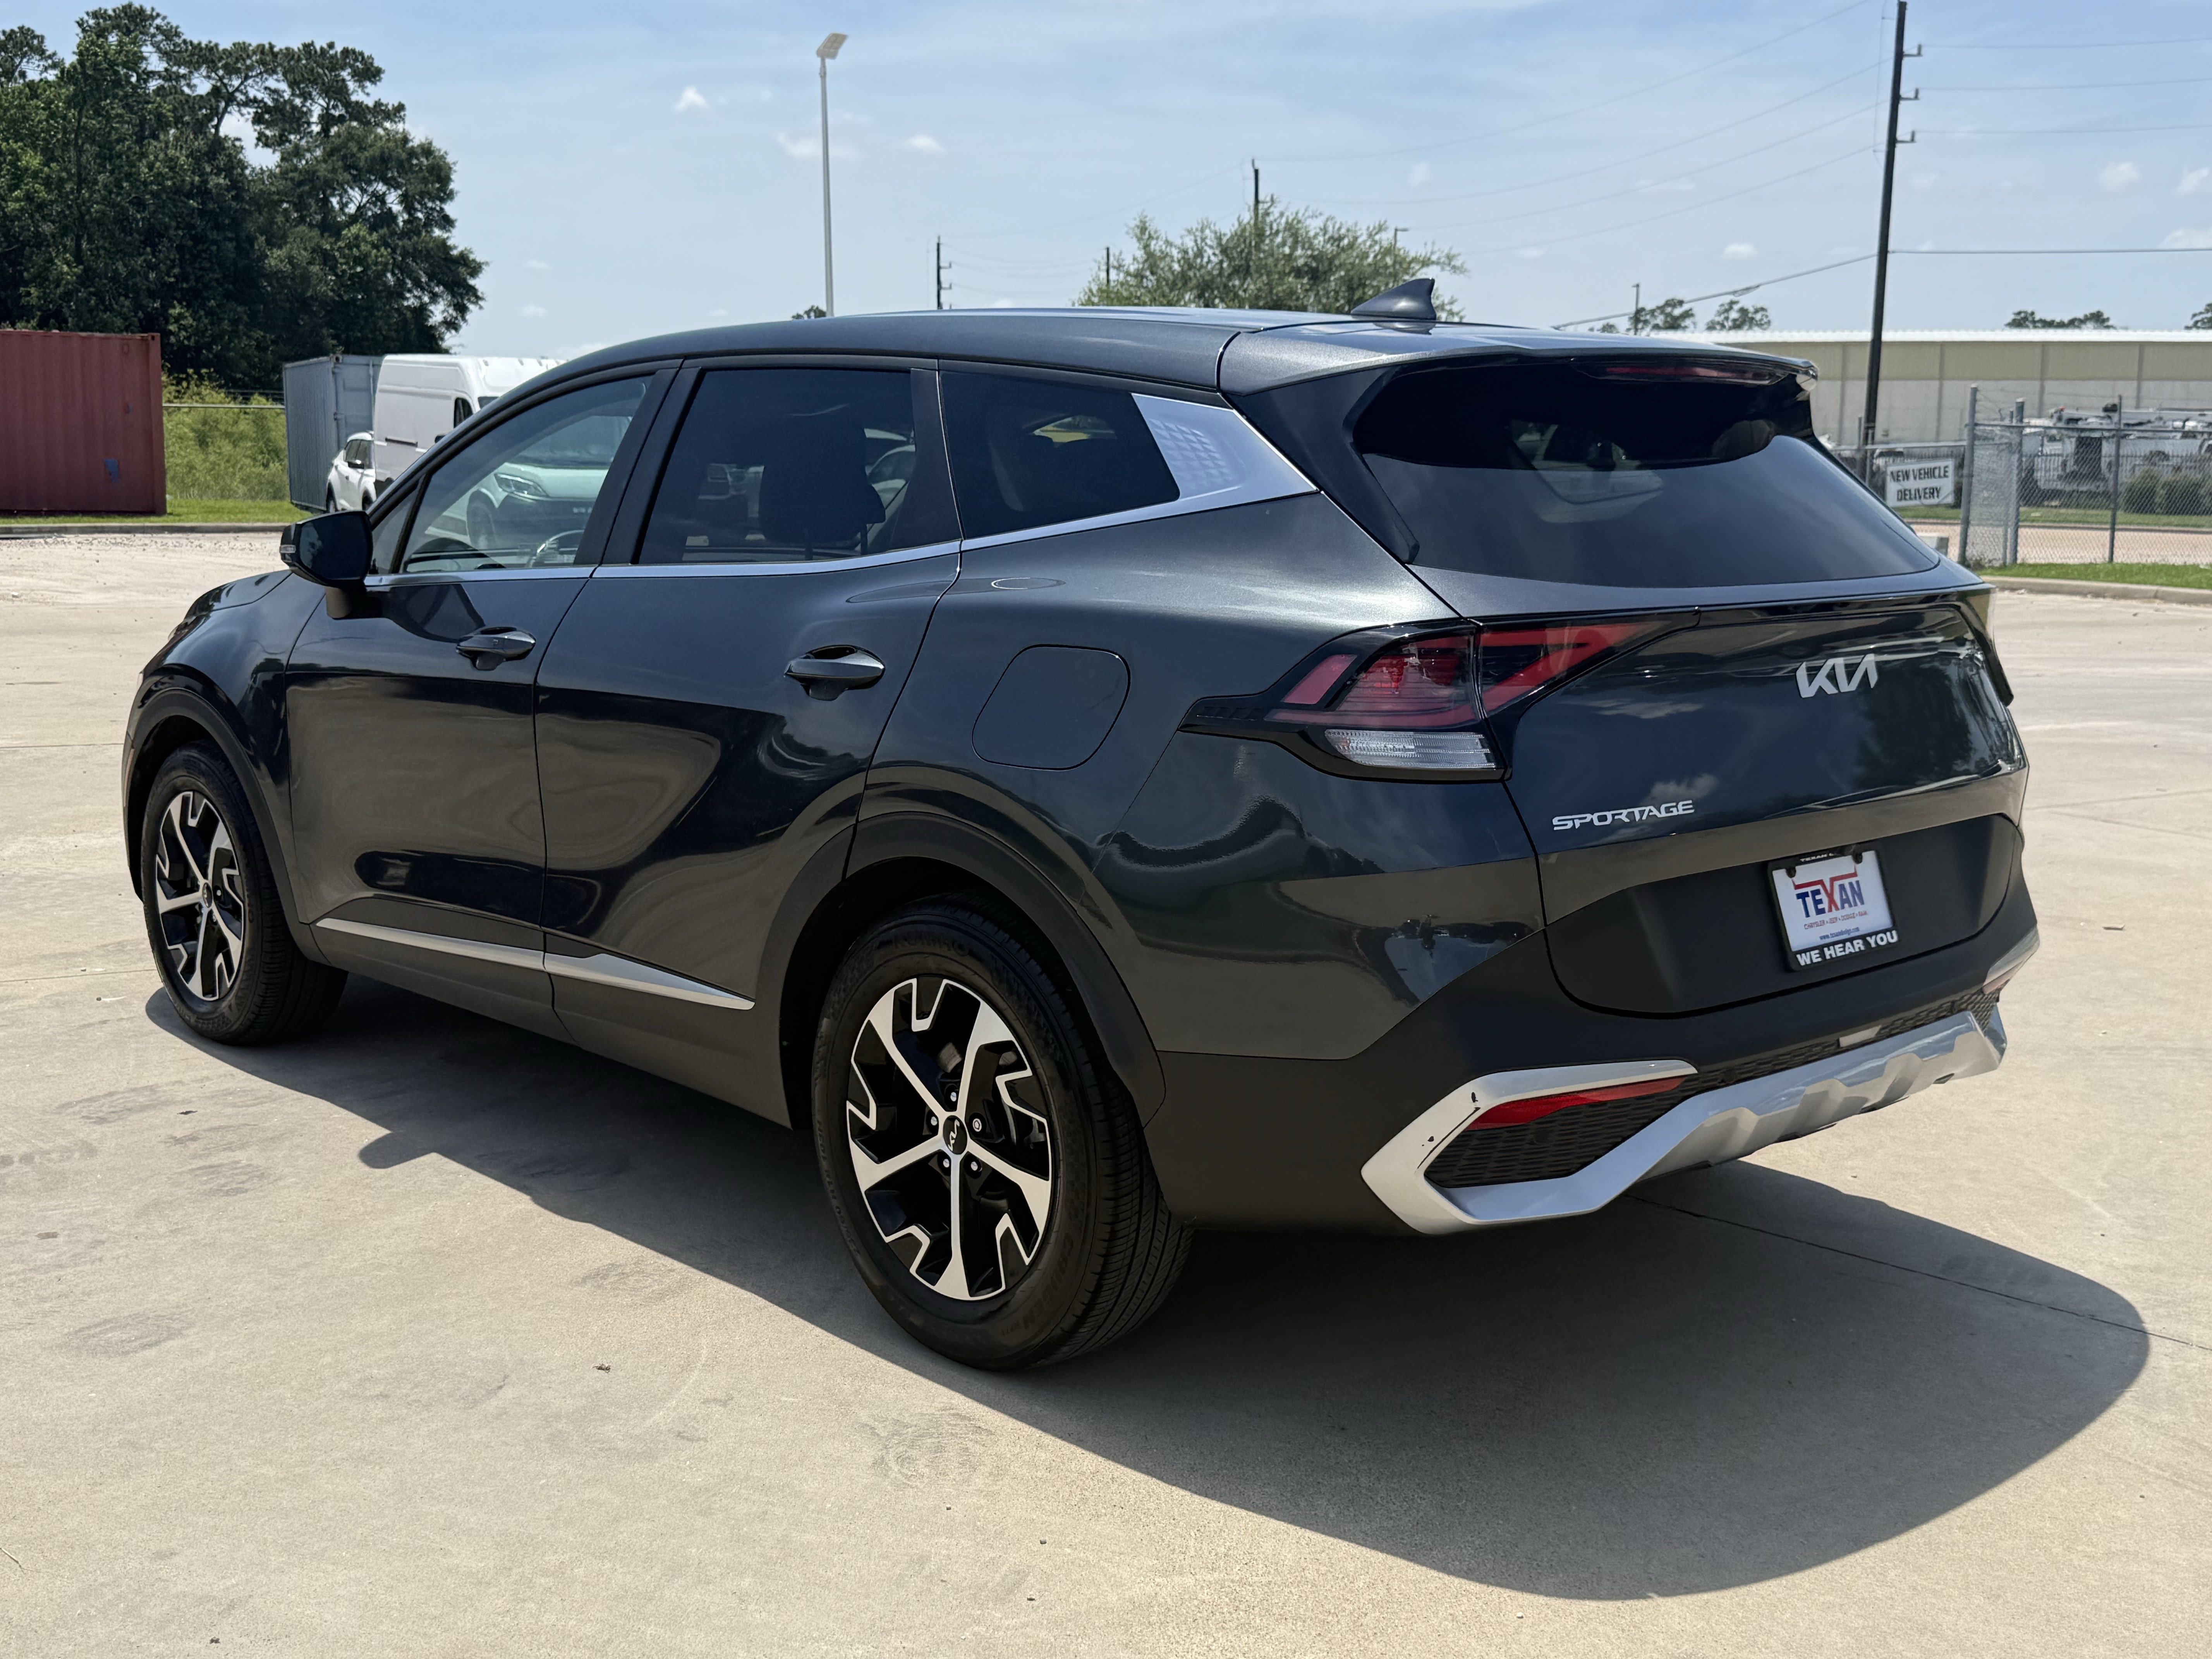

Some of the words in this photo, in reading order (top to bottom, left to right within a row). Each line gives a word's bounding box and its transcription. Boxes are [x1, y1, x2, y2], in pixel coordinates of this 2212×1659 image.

[1890, 469, 1910, 482] NEW
[1912, 465, 1949, 480] VEHICLE
[1897, 486, 1940, 502] DELIVERY
[1796, 653, 1878, 698] KIA
[1553, 800, 1695, 830] SPORTAGE
[1796, 878, 1865, 918] TEXAN
[1796, 949, 1822, 966] WE
[1824, 939, 1865, 960] HEAR
[1865, 930, 1899, 948] YOU
